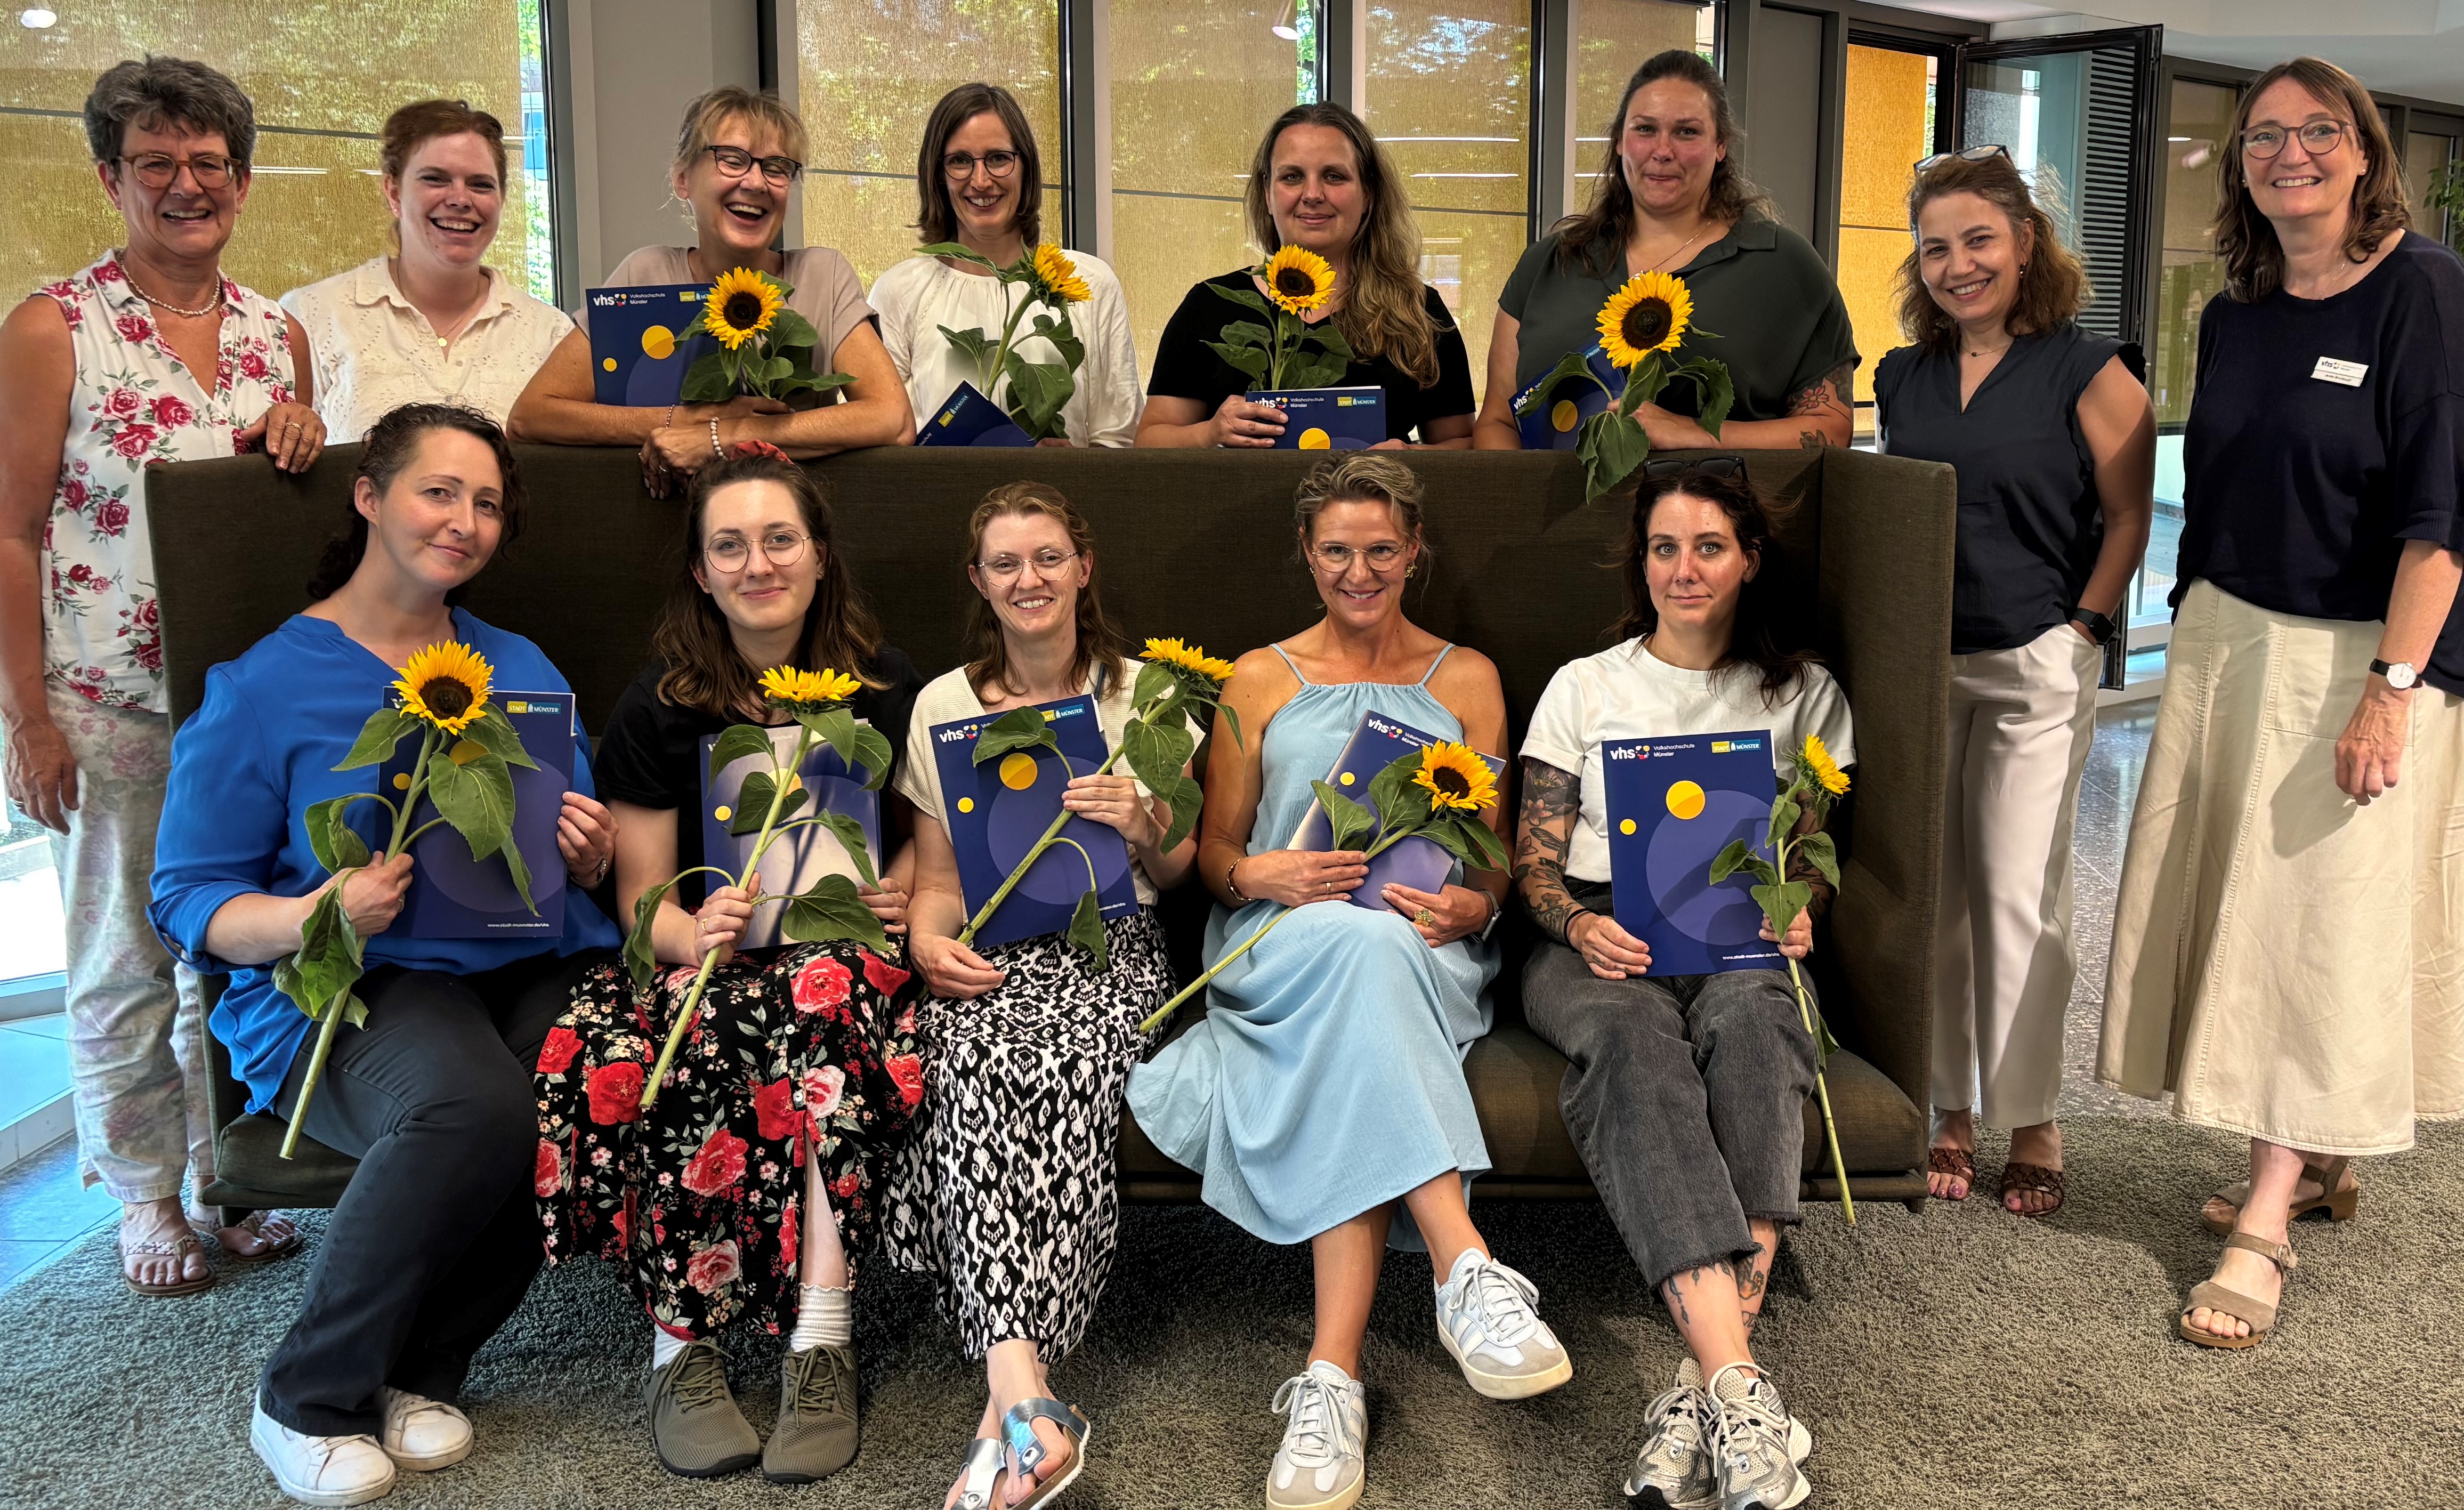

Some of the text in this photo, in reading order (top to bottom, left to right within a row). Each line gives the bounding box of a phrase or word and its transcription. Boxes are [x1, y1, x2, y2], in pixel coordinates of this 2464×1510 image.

[593, 294, 615, 306] vhs
[1514, 395, 1528, 410] vhs
[1368, 719, 1389, 733] vhs
[939, 729, 965, 742] vhs
[1610, 747, 1635, 760] vhs
